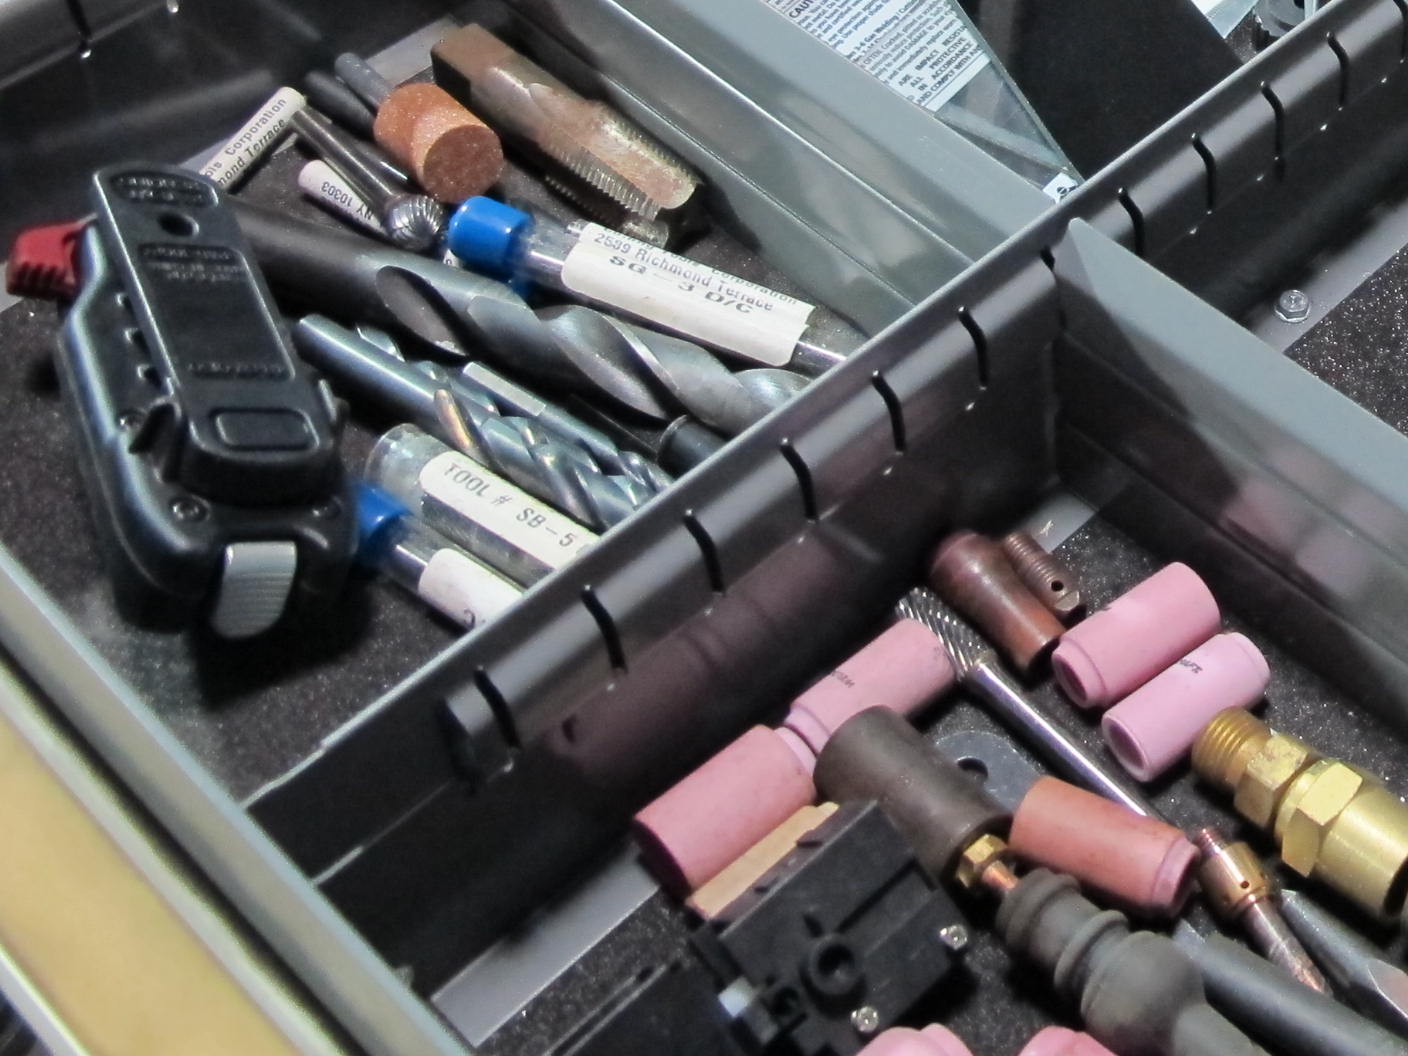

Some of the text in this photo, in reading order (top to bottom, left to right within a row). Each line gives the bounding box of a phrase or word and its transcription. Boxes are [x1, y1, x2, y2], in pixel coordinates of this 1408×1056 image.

[898, 74, 912, 85] ARE
[914, 50, 940, 70] IMPACT
[909, 76, 923, 86] ALL
[927, 37, 968, 69] PROTECTIVE
[917, 42, 976, 91] IN ACCORDANCE
[930, 70, 956, 91] COMPLY
[953, 56, 972, 71] WITH
[225, 97, 287, 156] Corporation
[248, 117, 287, 157] Terrace
[321, 180, 353, 208] 10303
[635, 247, 714, 287] Richmond
[715, 280, 775, 312] Terrace
[711, 267, 797, 306] Corporation
[444, 462, 491, 497] TOOL
